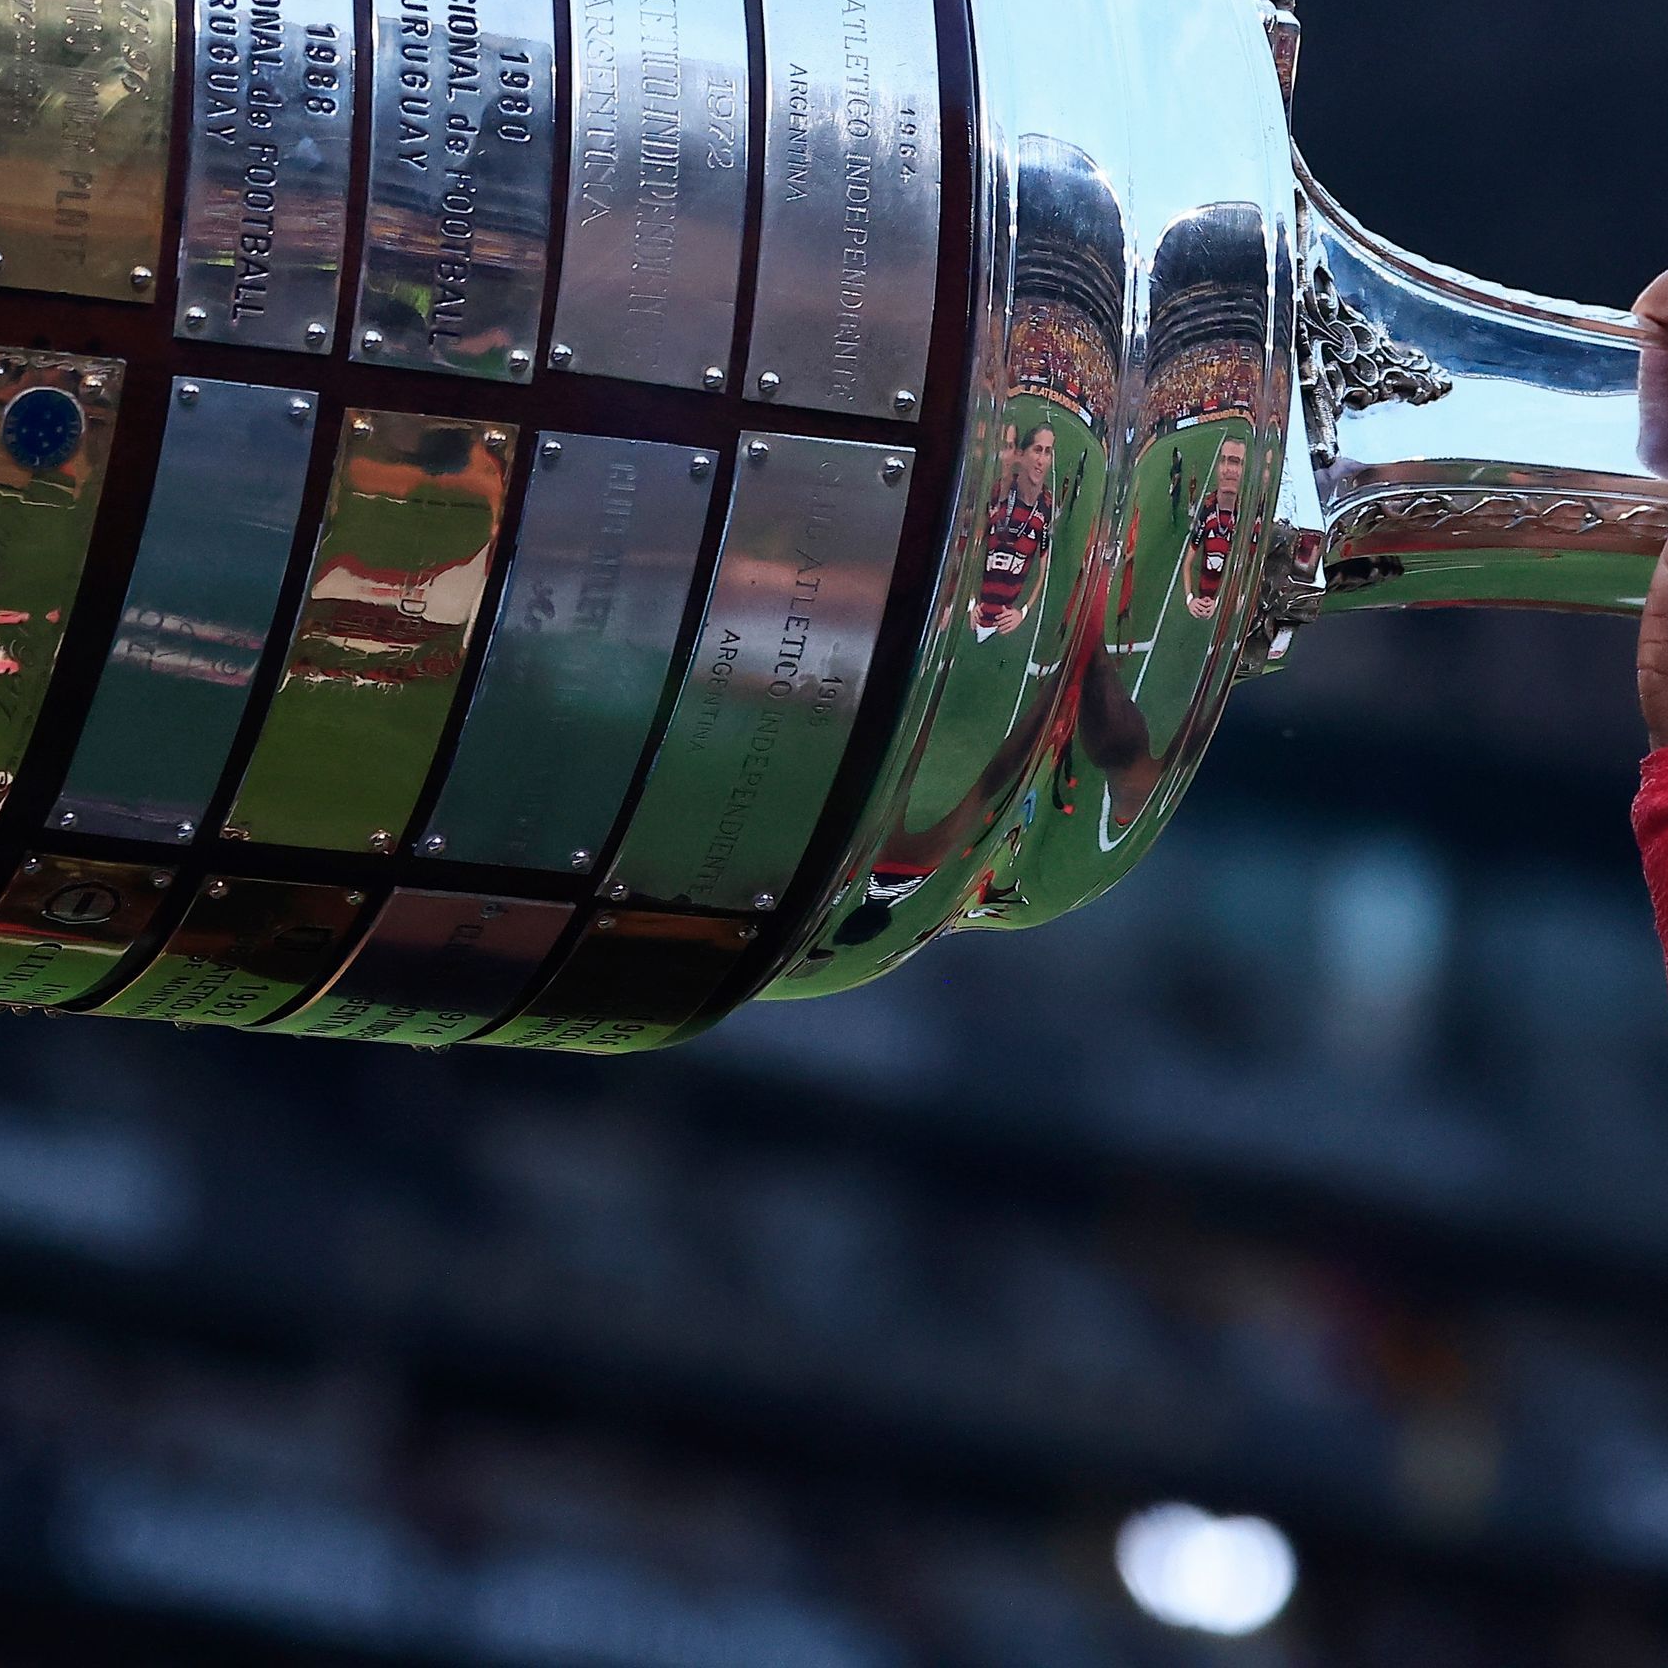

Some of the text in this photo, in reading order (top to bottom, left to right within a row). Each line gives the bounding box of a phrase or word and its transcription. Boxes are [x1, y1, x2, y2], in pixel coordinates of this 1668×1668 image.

[63, 69, 101, 153] RIVER
[246, 82, 282, 131] de
[305, 23, 341, 117] 1988
[498, 51, 532, 143] 1980
[444, 113, 480, 156] de
[707, 75, 738, 171] 1972
[786, 63, 809, 203] ARGENTINA
[898, 107, 918, 185] 1964
[53, 170, 93, 266] PLATE
[233, 143, 281, 324] FOOTBALL
[427, 163, 476, 347] FOOTBALL
[766, 548, 823, 700] ATLETICO
[687, 628, 741, 755] ARGENTINA
[689, 712, 780, 897] INDEPENDIENTE
[3, 943, 63, 982] CLUB
[169, 963, 242, 1011] ATLETICO
[201, 984, 270, 1017] 1982
